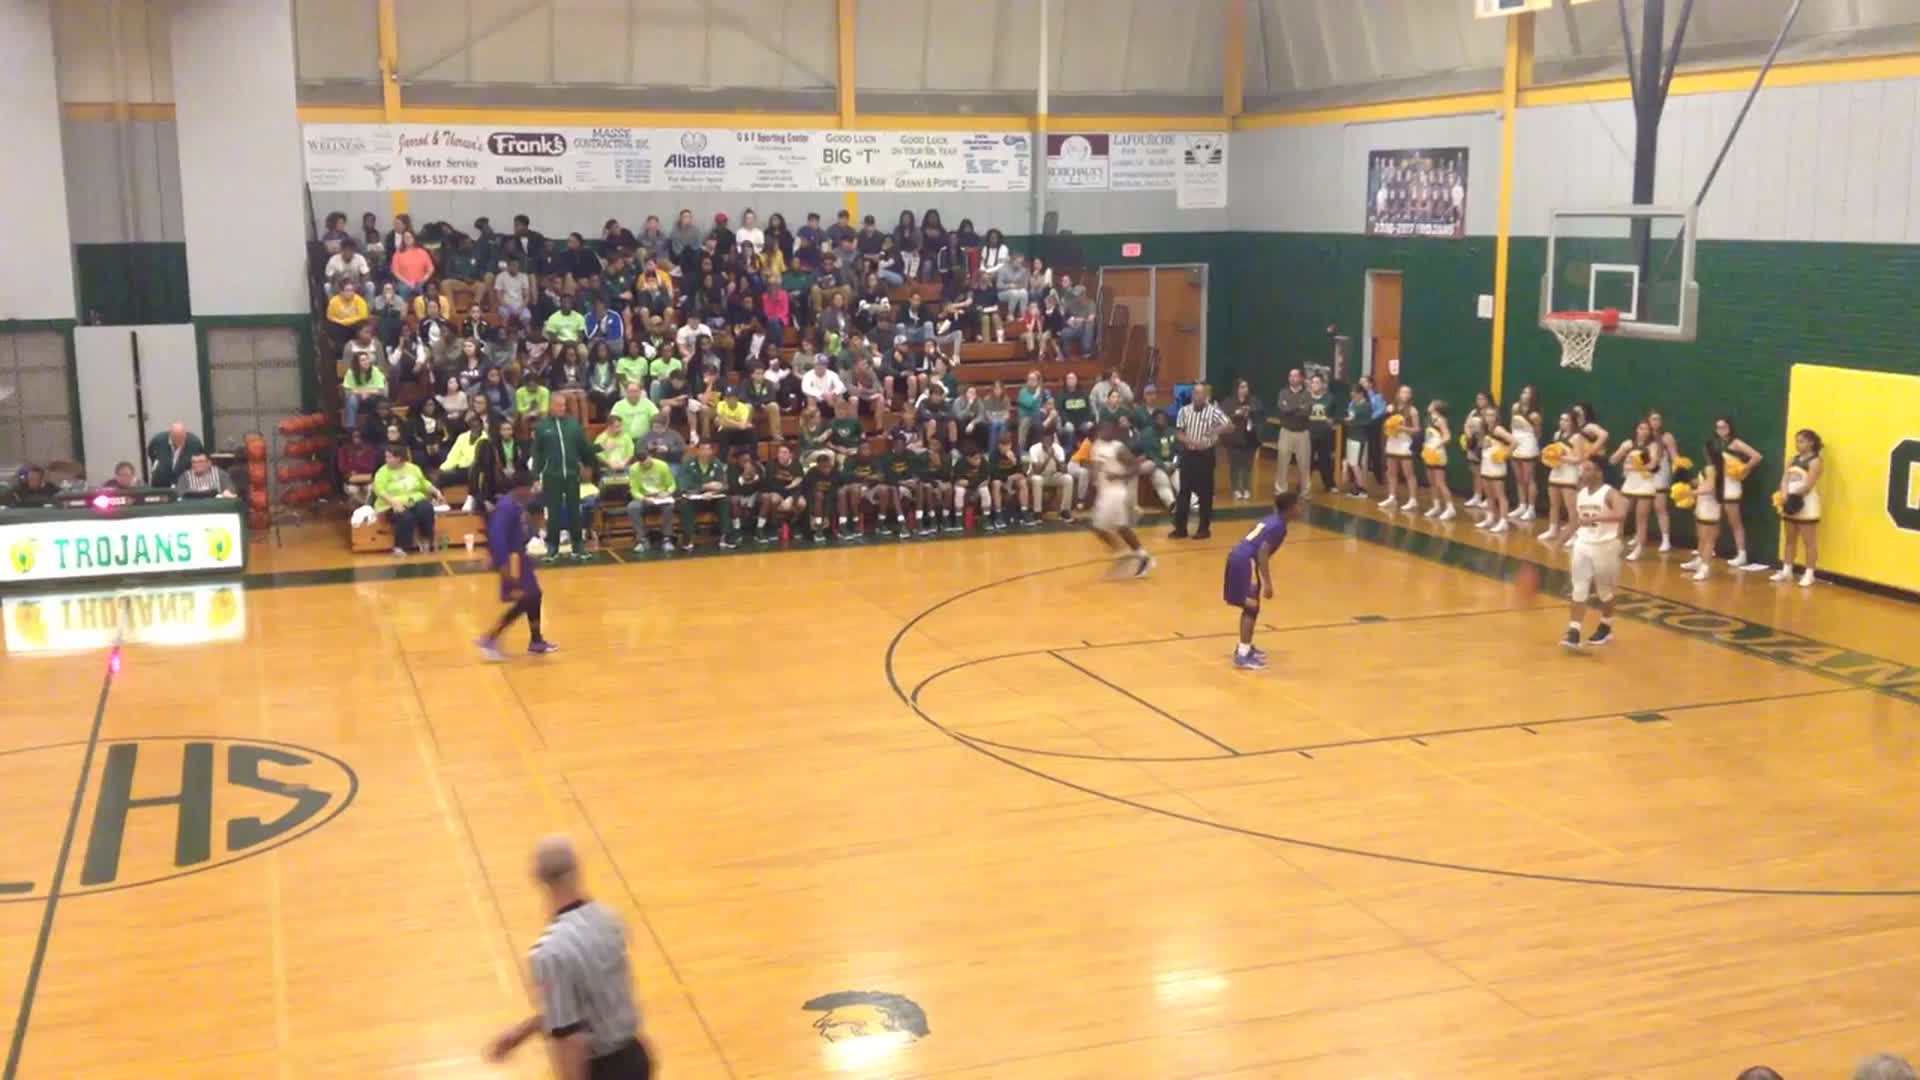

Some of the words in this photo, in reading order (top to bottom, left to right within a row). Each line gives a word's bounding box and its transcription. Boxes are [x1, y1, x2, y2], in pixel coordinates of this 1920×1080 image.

[493, 134, 564, 154] Frank's
[446, 157, 478, 168] Service
[664, 154, 726, 169] Allstate
[823, 148, 852, 164] BIG
[495, 174, 562, 185] Basketball
[53, 532, 193, 569] TROJANS
